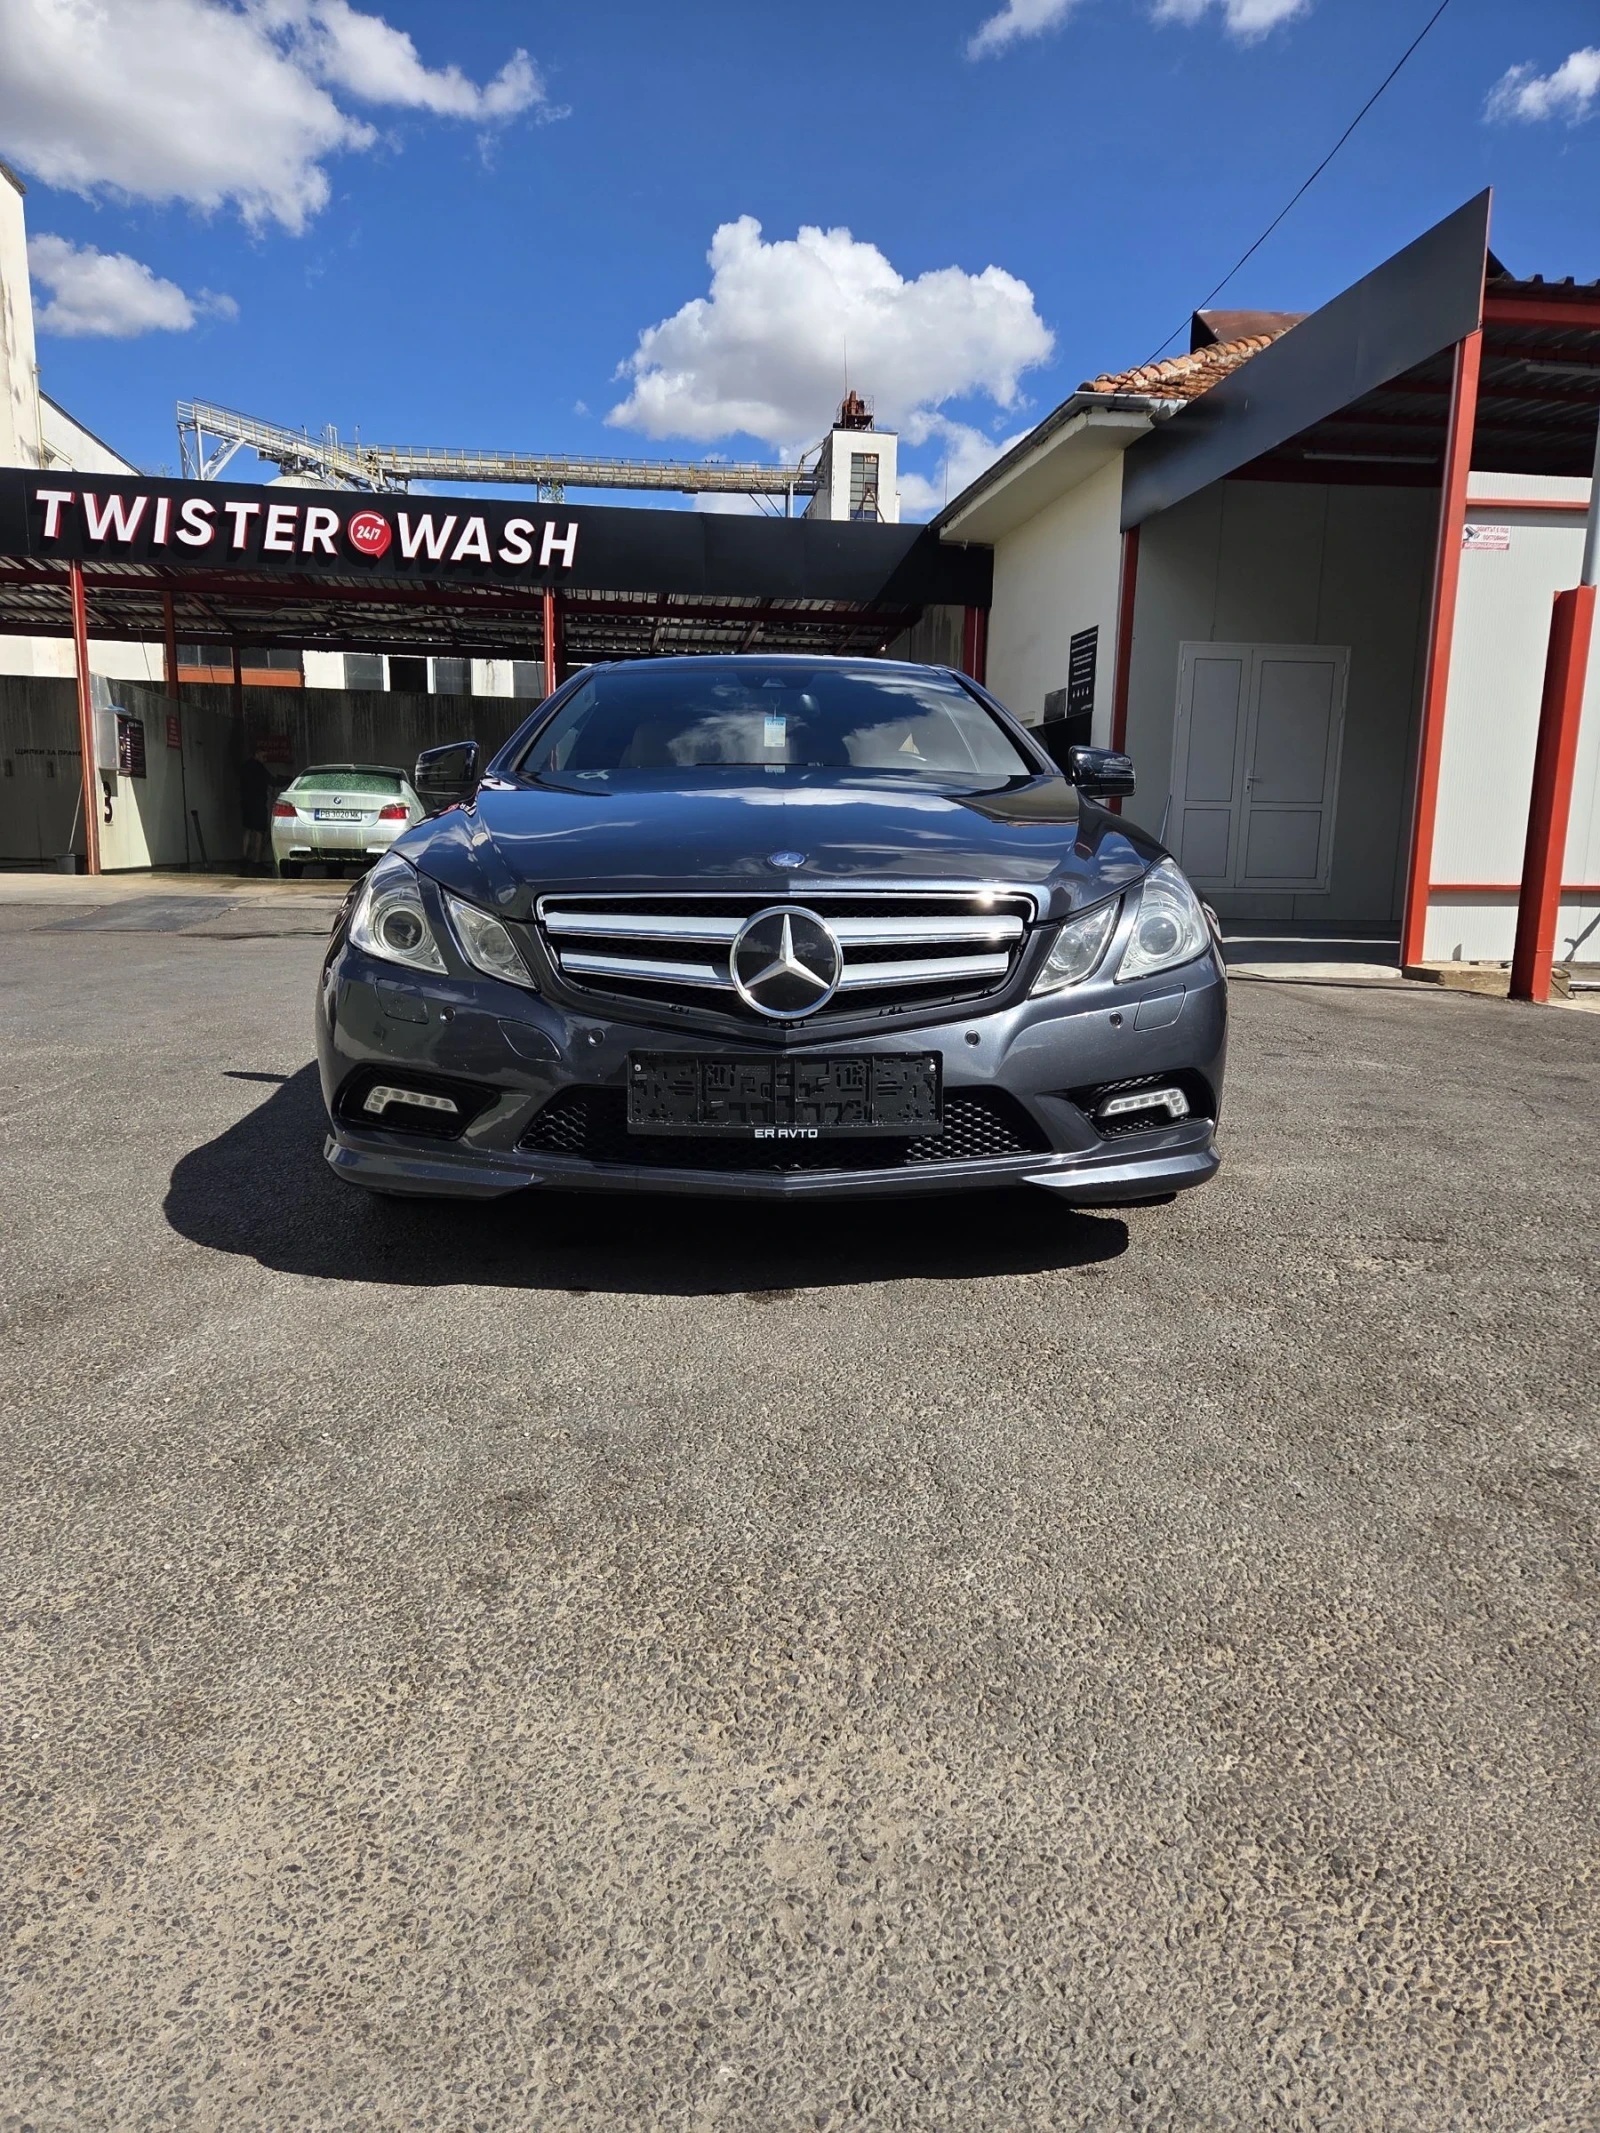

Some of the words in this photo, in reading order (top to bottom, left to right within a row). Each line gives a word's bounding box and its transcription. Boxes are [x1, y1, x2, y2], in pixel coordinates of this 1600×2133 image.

[35, 489, 340, 555] TWISTER
[356, 525, 381, 541] 24/7
[397, 512, 579, 568] WASH
[46, 748, 56, 756] ЗА
[102, 781, 113, 823] 3
[754, 1129, 775, 1138] ER
[778, 1129, 818, 1138] AVTO
